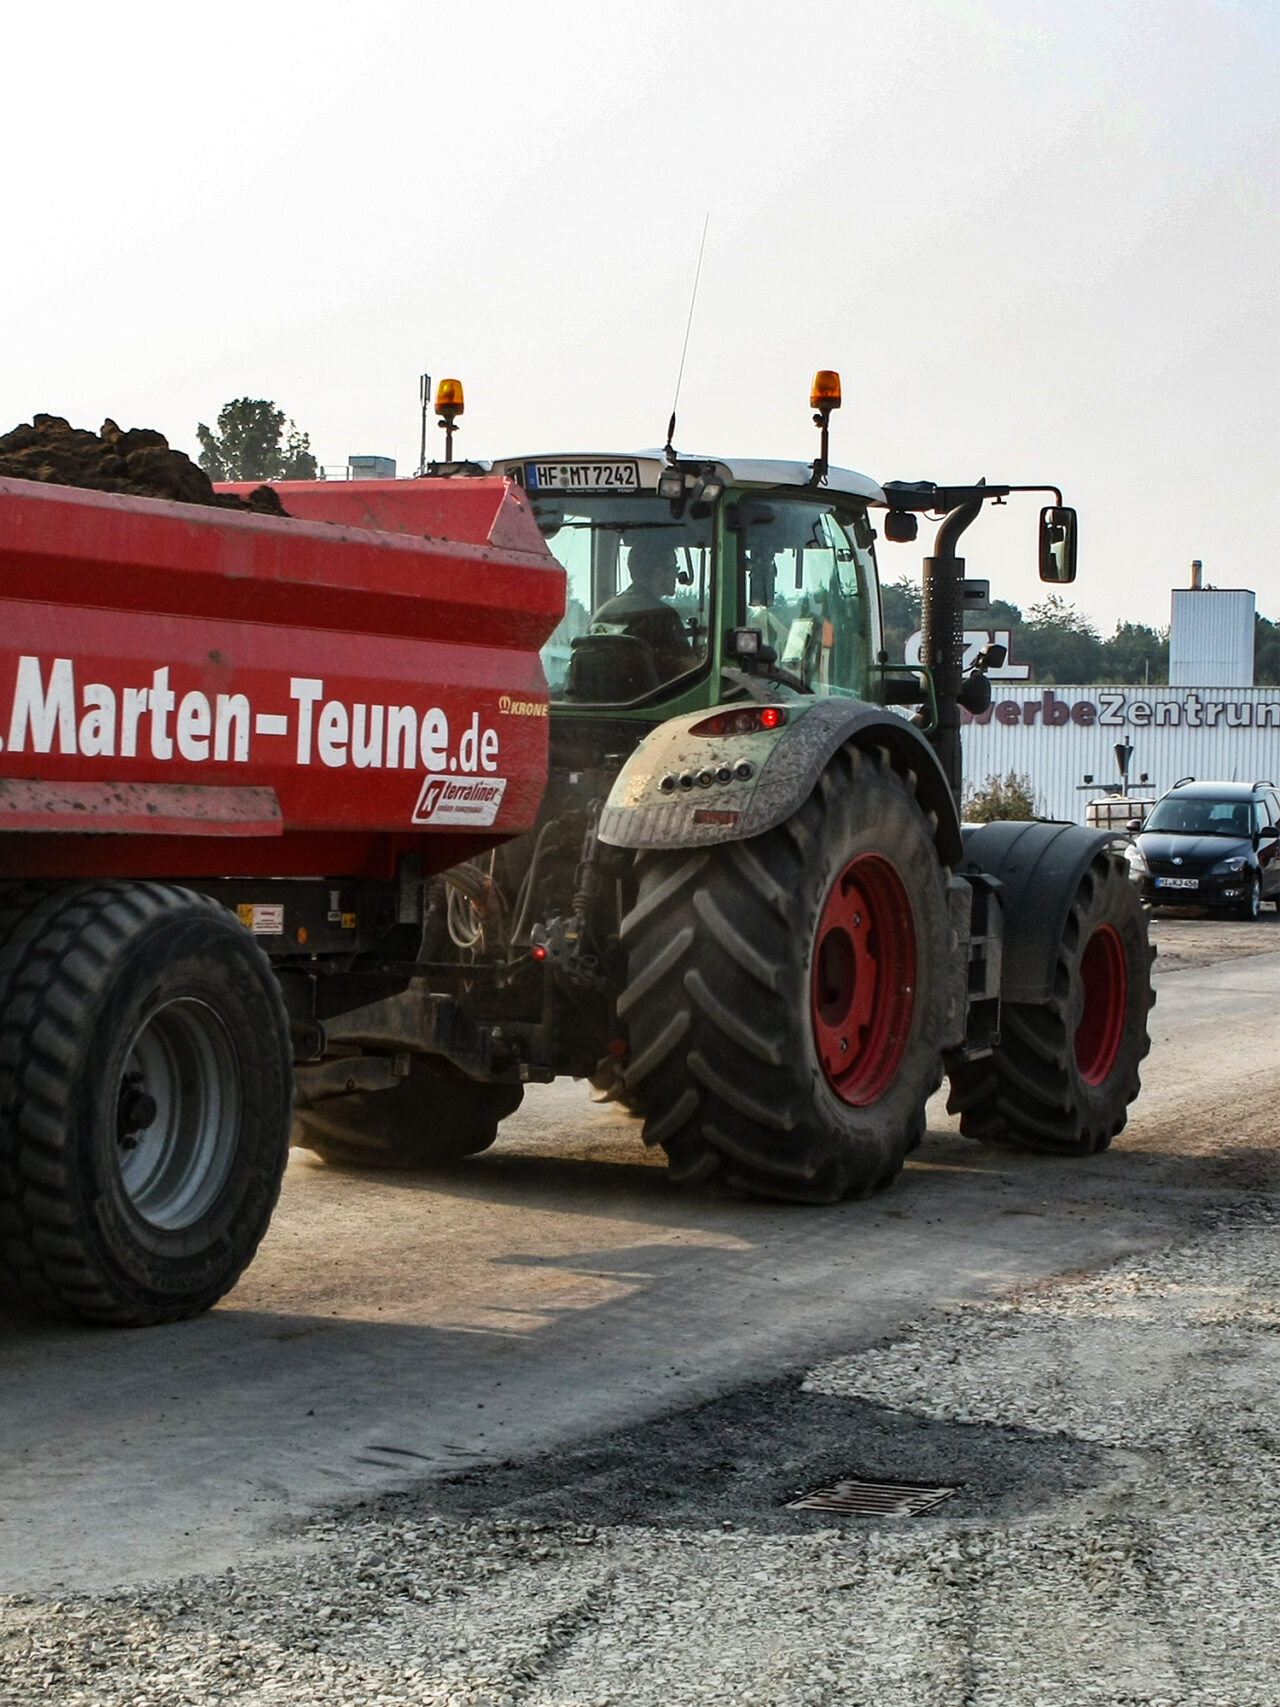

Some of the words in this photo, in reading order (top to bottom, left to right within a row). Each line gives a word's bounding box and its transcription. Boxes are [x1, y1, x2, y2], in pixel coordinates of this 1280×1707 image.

[538, 466, 557, 486] HF
[570, 466, 590, 486] MT
[593, 465, 634, 486] 7242
[510, 701, 548, 717] KRONE
[442, 781, 499, 802] terraliner
